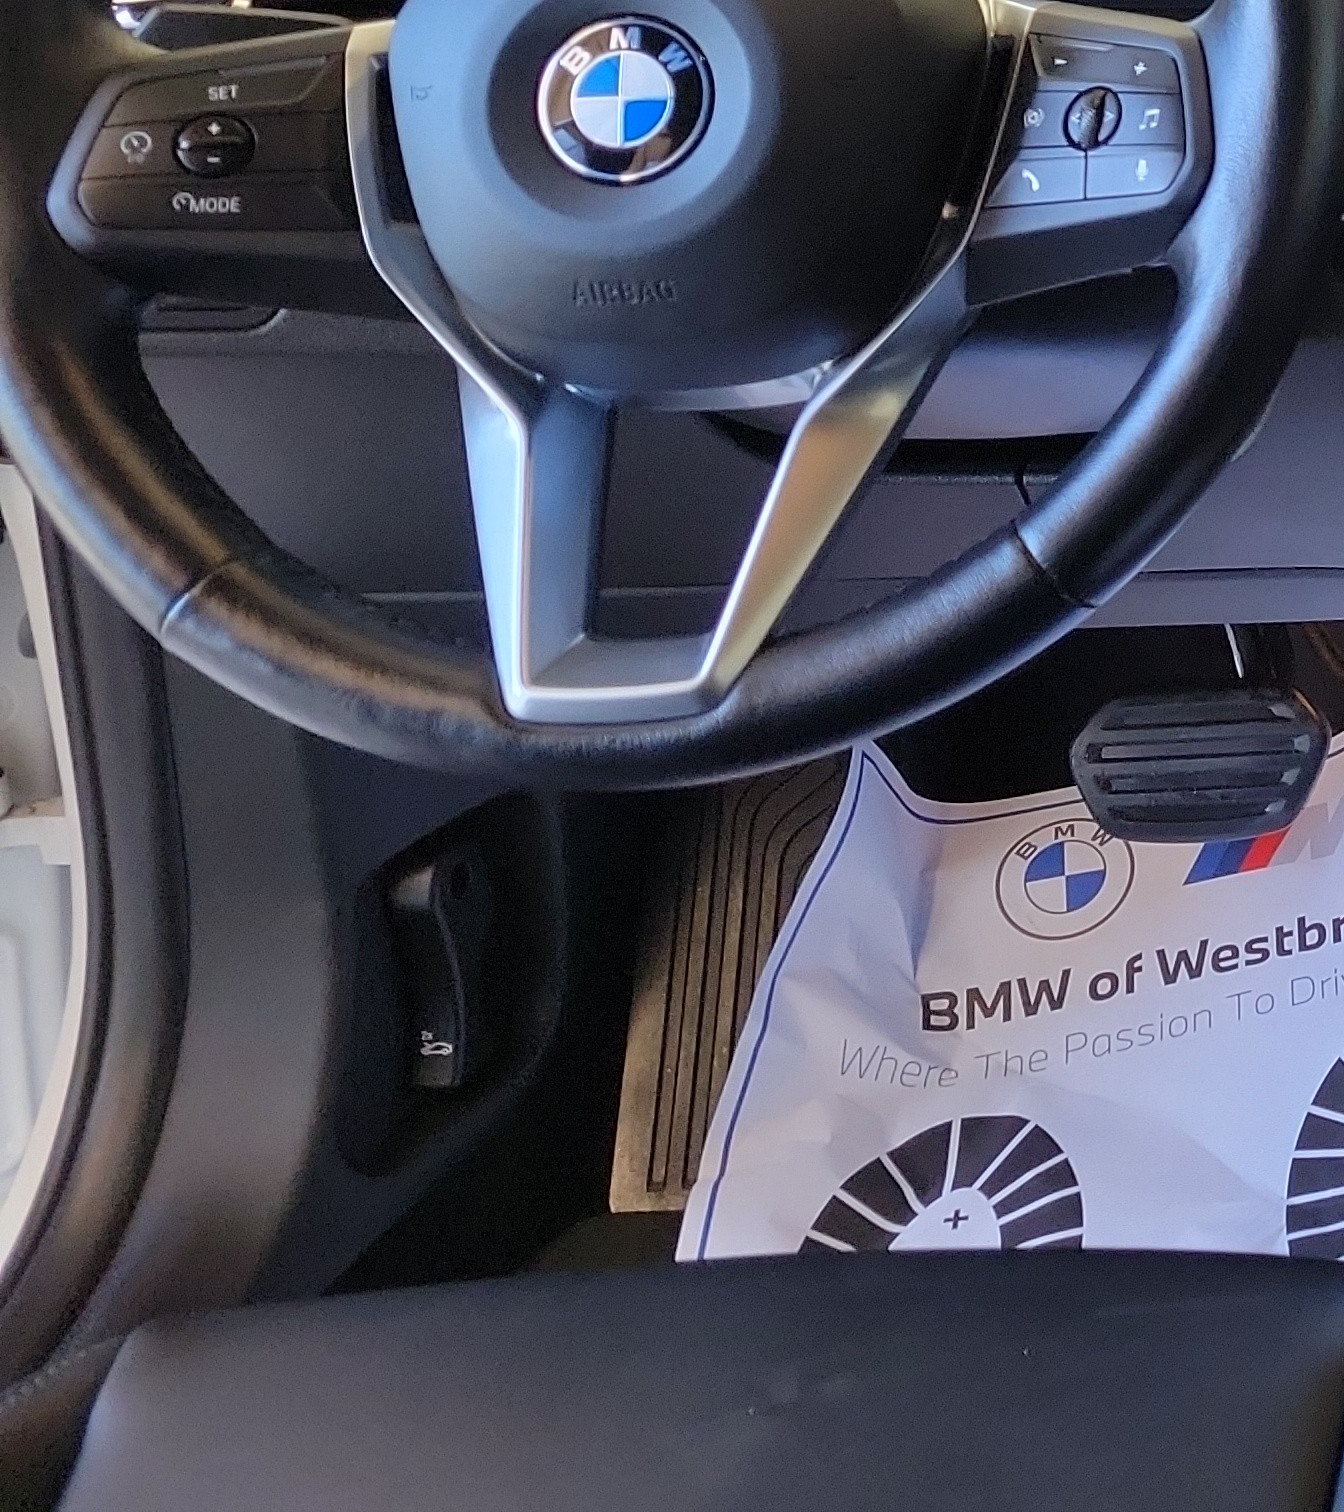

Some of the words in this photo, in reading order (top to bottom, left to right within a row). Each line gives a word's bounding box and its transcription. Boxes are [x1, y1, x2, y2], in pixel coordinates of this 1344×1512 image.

[559, 25, 694, 76] BMW
[207, 84, 240, 102] SET
[189, 195, 242, 214] MODE
[572, 278, 678, 307] AIRBAG
[1014, 823, 1119, 862] BMW
[920, 967, 1072, 1033] BMW
[1088, 952, 1143, 1002] of
[839, 1038, 959, 1090] Where
[974, 1048, 1049, 1081] The
[1064, 1007, 1213, 1066] Passion
[1226, 989, 1275, 1021] To
